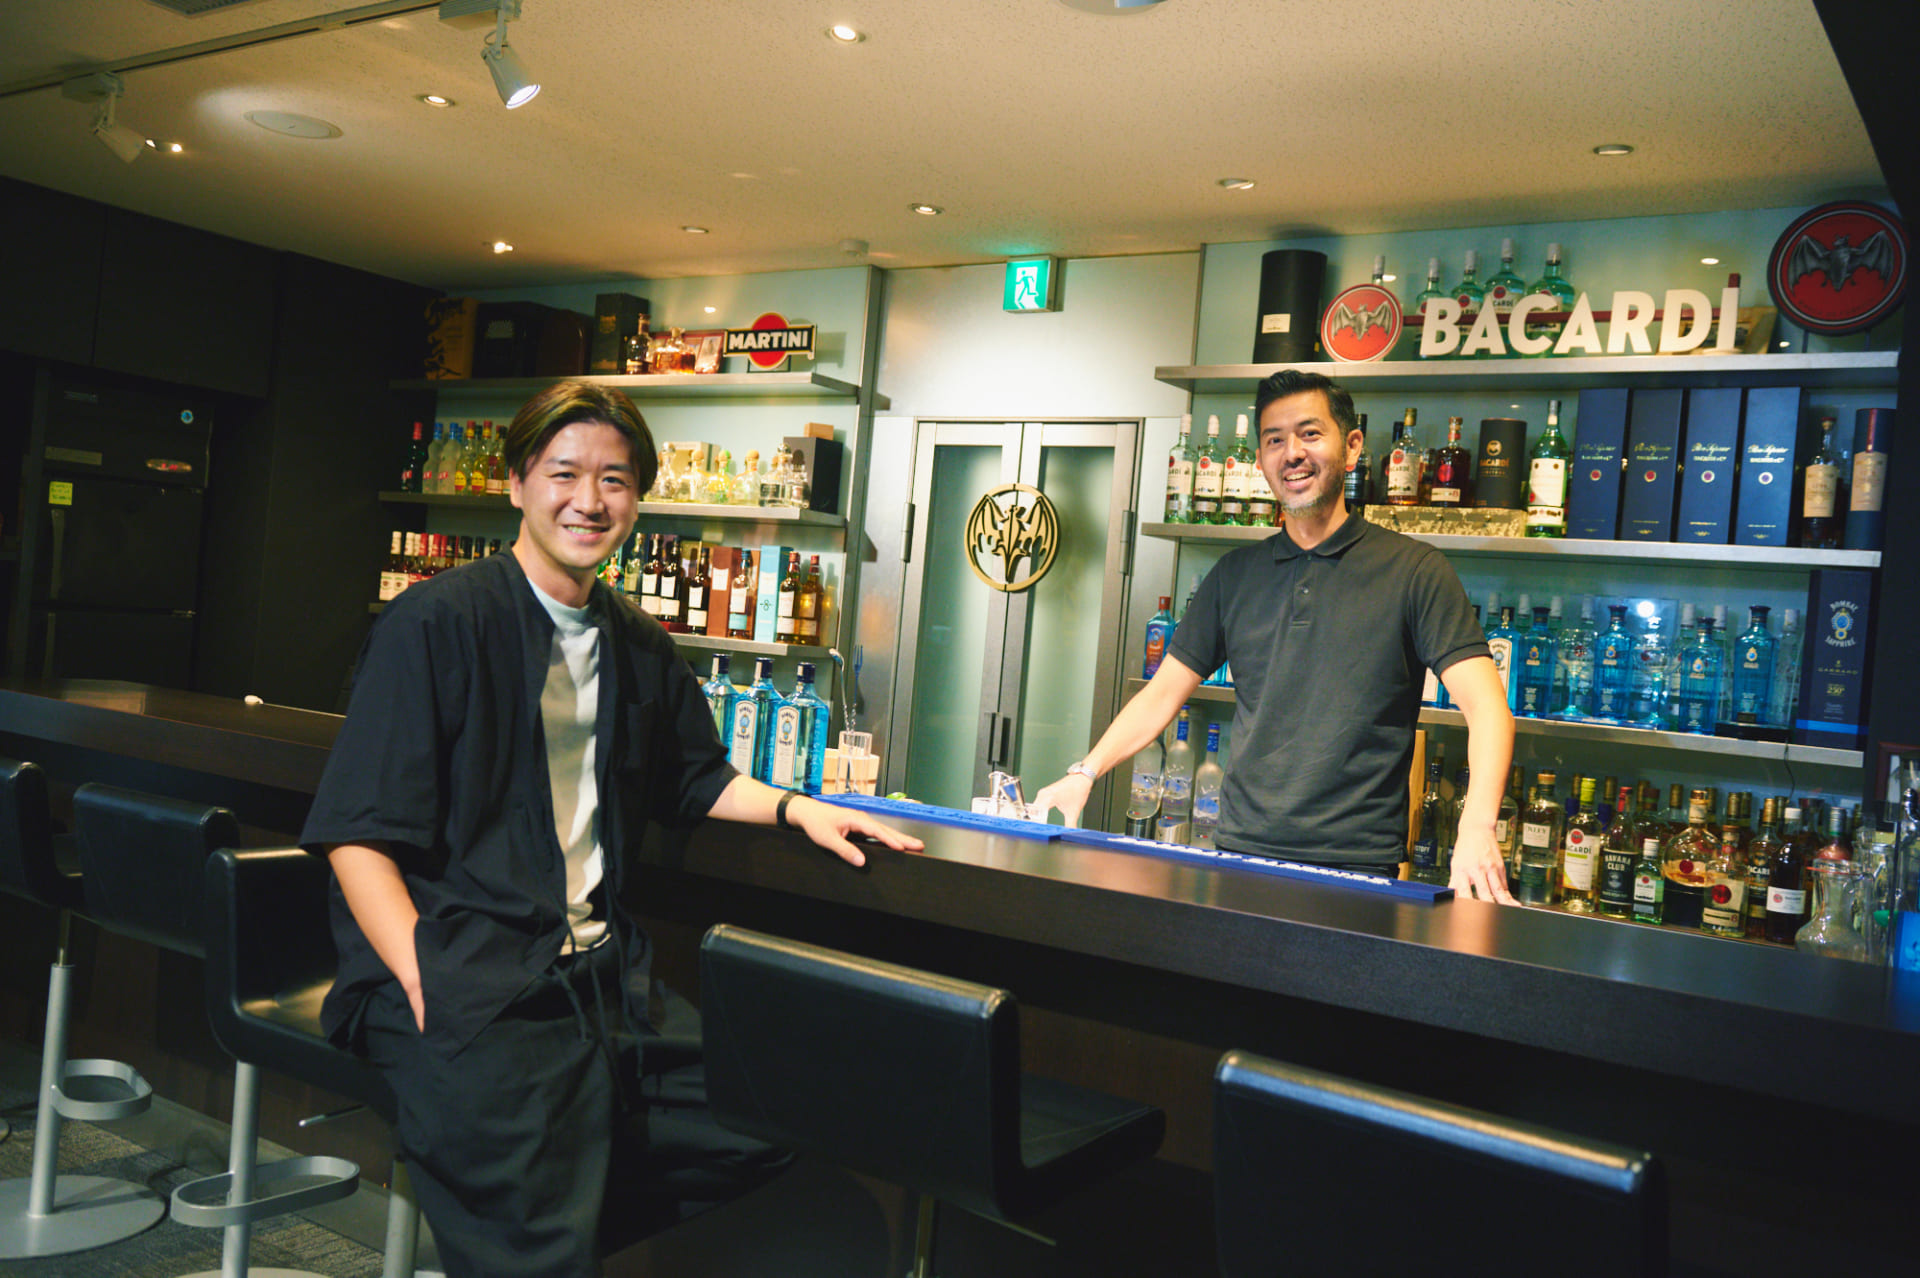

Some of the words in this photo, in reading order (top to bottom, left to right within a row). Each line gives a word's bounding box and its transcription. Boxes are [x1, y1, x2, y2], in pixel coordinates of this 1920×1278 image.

[729, 331, 808, 350] MARTINI
[1604, 854, 1631, 865] HAVANA
[1607, 862, 1625, 871] CLUB
